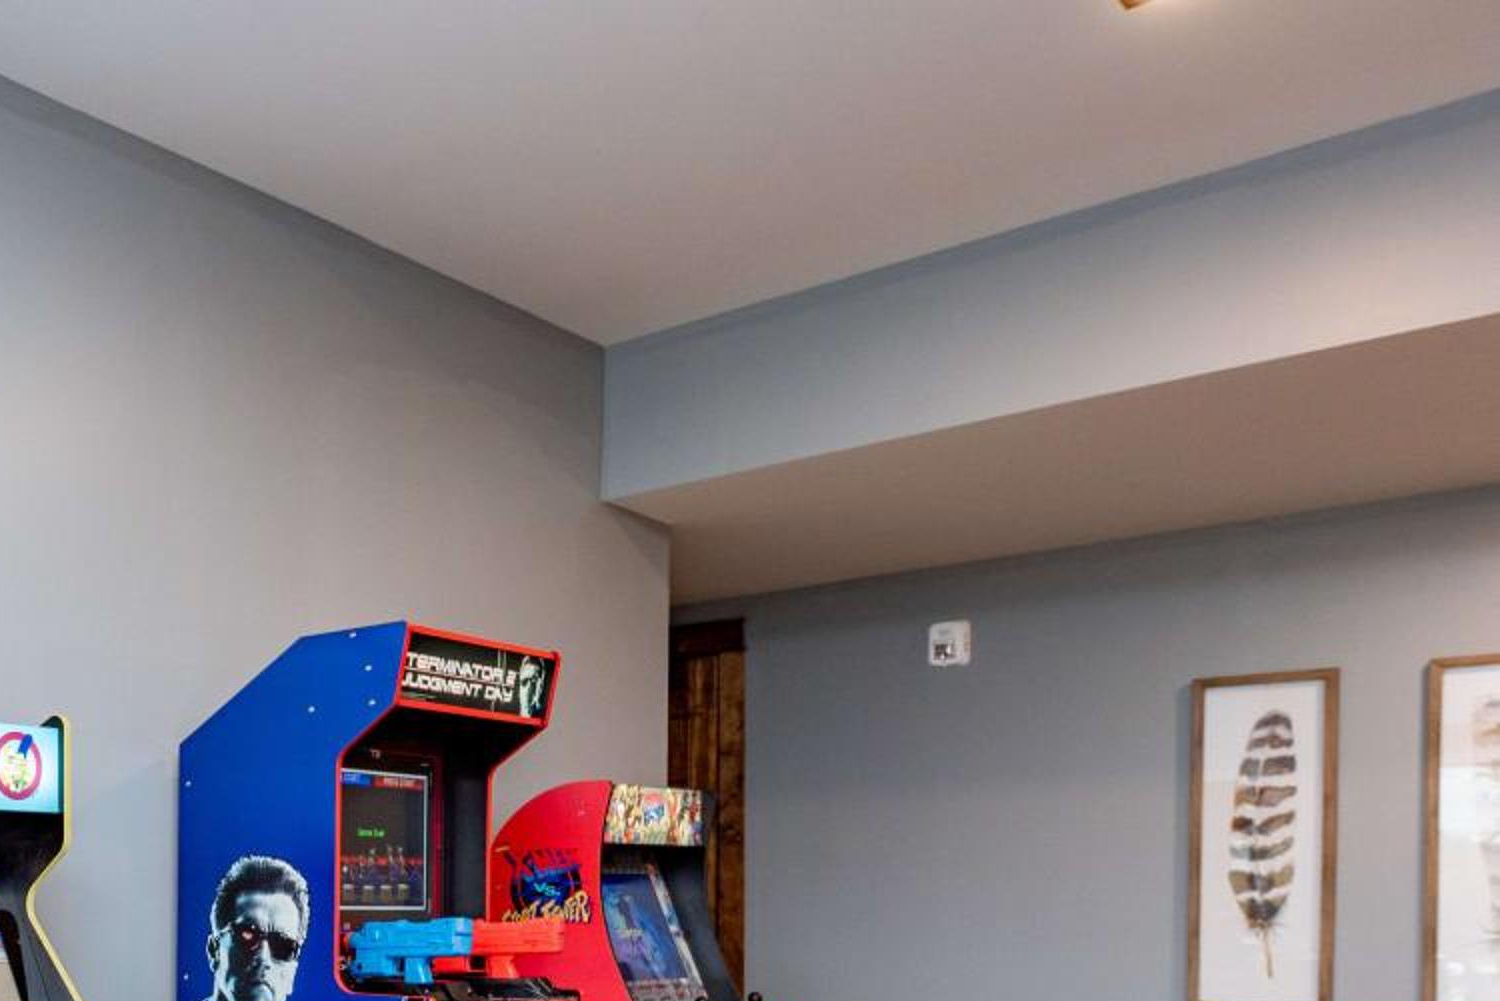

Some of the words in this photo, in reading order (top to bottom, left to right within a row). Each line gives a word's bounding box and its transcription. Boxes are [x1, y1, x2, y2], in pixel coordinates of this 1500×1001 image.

[405, 651, 504, 686] TERMINATOR
[402, 672, 483, 697] JUDGMENT
[484, 685, 513, 703] DAY
